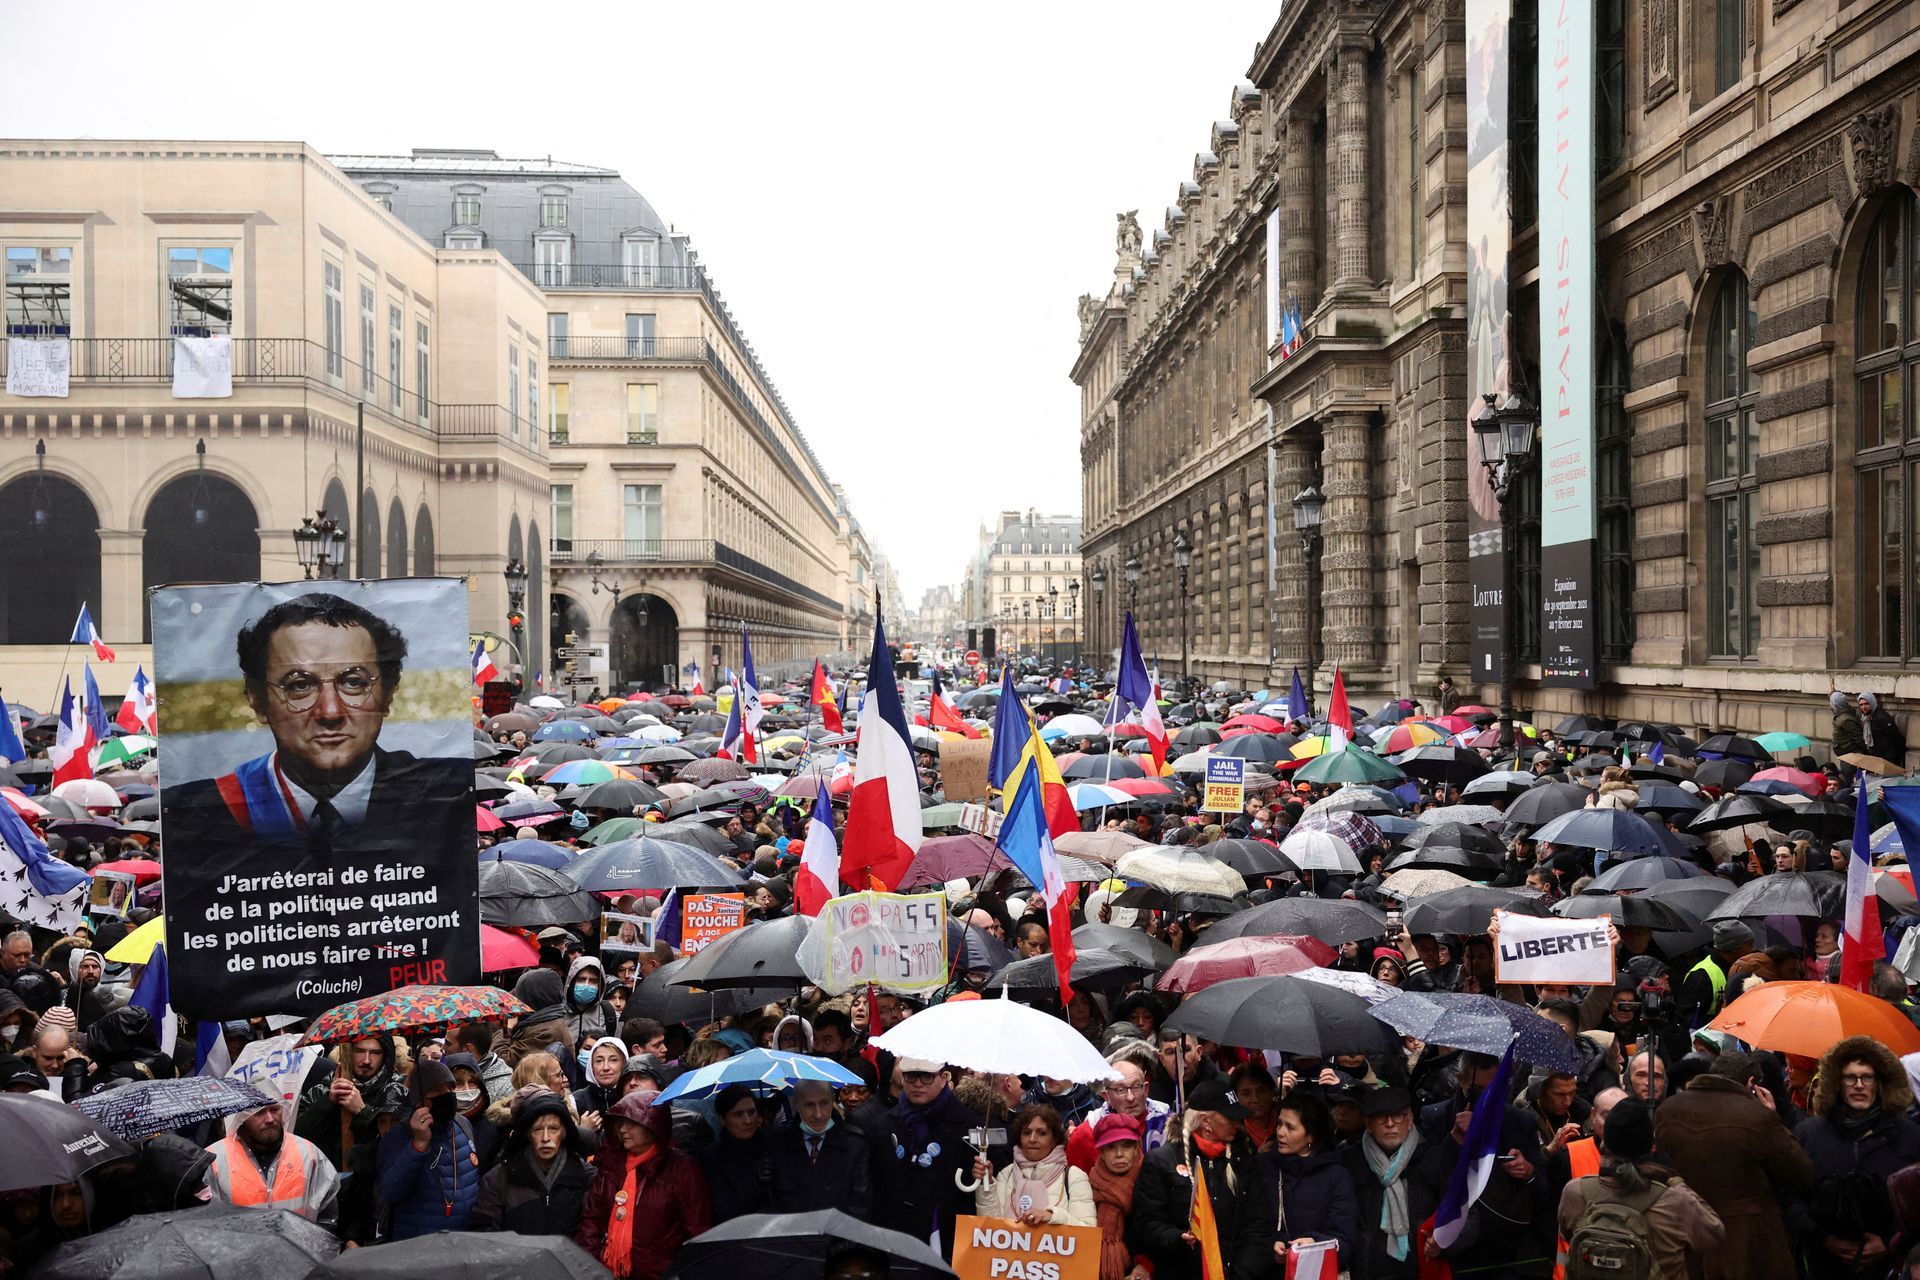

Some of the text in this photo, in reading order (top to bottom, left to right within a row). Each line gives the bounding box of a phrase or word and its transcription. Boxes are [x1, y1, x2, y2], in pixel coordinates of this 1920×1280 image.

[1554, 577, 1577, 596] Exposition
[1556, 596, 1577, 615] septembre
[1213, 761, 1237, 770] JAIL
[1208, 786, 1240, 797] FREE
[340, 866, 369, 885] de
[374, 863, 426, 883] faire
[205, 885, 438, 922] de la politique quand
[688, 901, 714, 913] PAS
[688, 916, 739, 928] TOUCHE
[880, 903, 936, 928] PASS
[183, 910, 460, 951] les politiciens arrêteront
[685, 937, 714, 953] ENF
[1500, 926, 1609, 962] LIBERTÉ
[226, 954, 256, 973] de
[262, 950, 318, 969] nous
[322, 945, 371, 964] faire
[377, 941, 416, 960] rire
[390, 958, 448, 990] PEUR
[296, 975, 363, 1000] (Coluche)
[63, 1134, 98, 1154] Aurexia
[972, 1228, 1076, 1256] NON AU
[990, 1257, 1060, 1280] PASS
